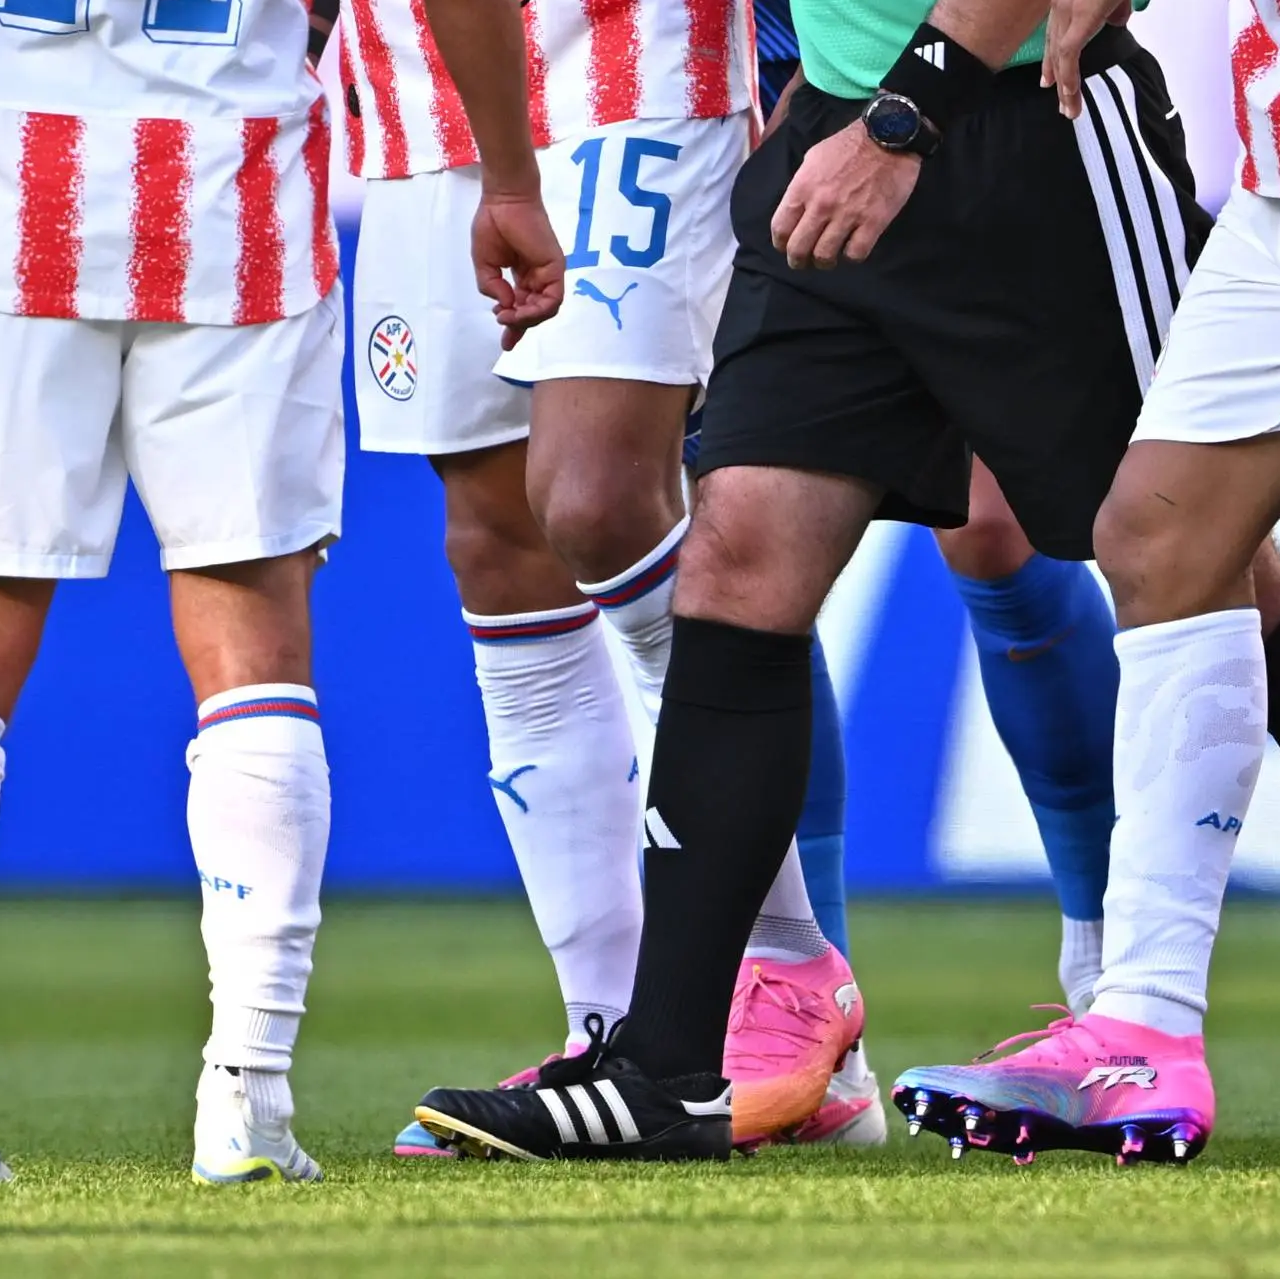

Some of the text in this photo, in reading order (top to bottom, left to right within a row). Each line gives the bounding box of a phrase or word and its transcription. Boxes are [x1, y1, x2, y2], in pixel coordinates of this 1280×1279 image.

[565, 136, 684, 272] 15
[386, 322, 402, 337] APF
[1109, 1055, 1148, 1066] FUTURE
